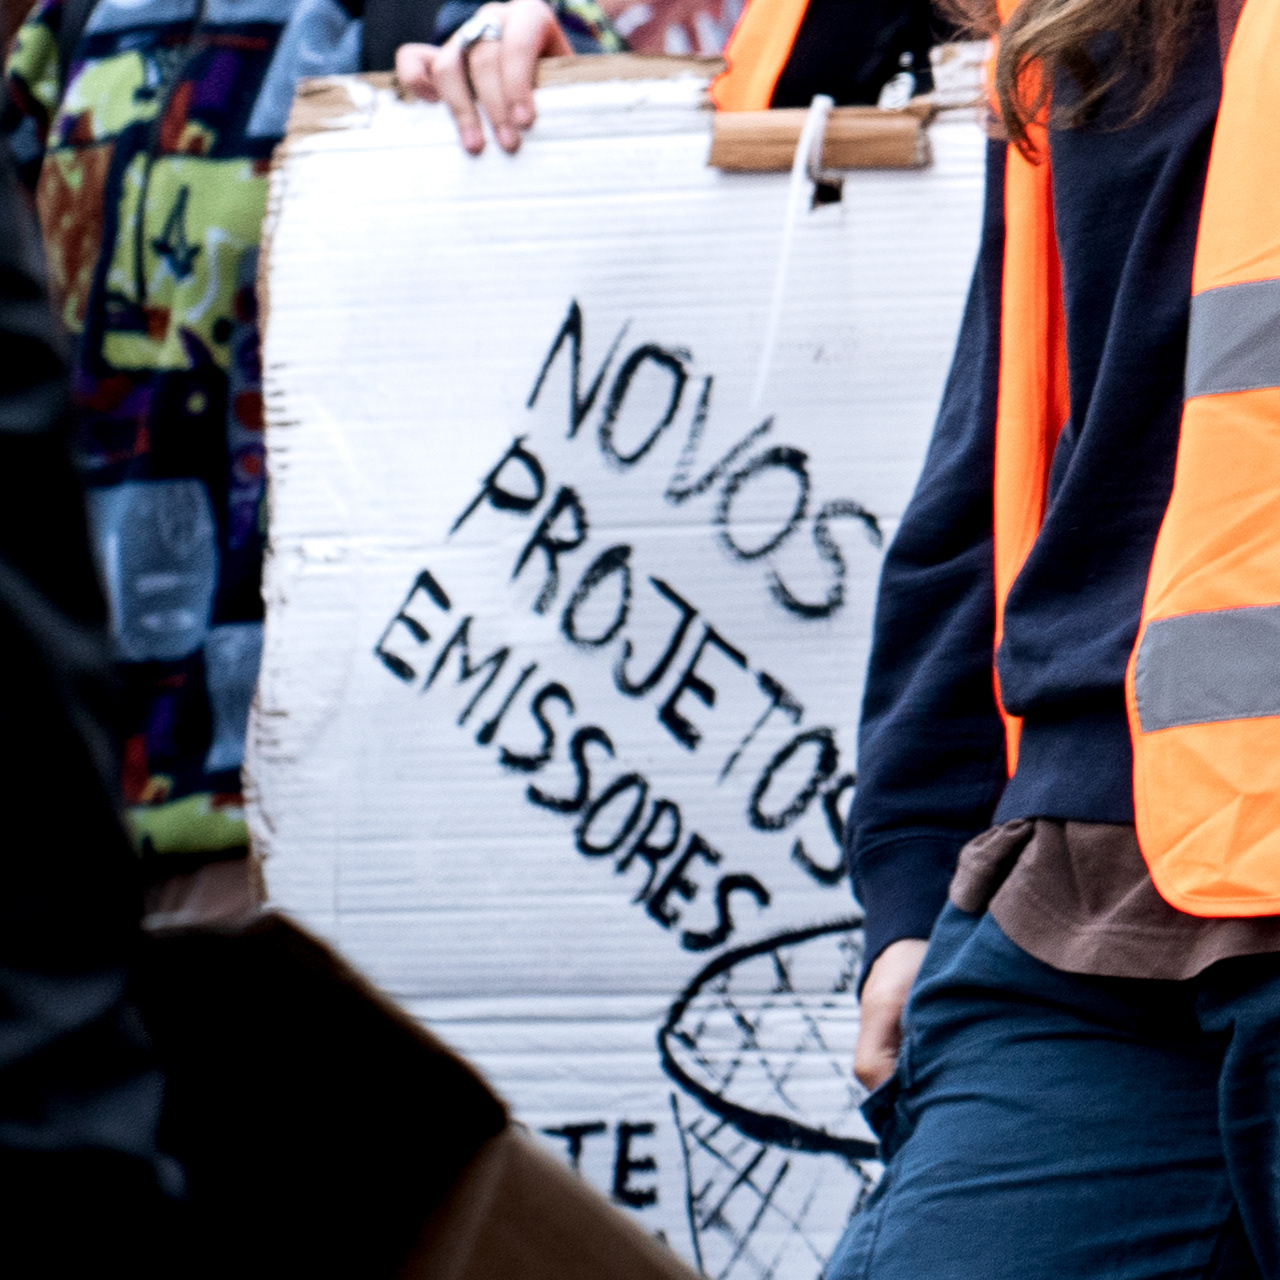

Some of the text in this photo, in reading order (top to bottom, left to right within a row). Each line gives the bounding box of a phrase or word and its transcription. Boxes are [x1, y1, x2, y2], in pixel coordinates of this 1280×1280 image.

[526, 296, 885, 619] NOVOS
[372, 568, 772, 953] EMISSORES
[446, 433, 856, 889] PROJETOS
